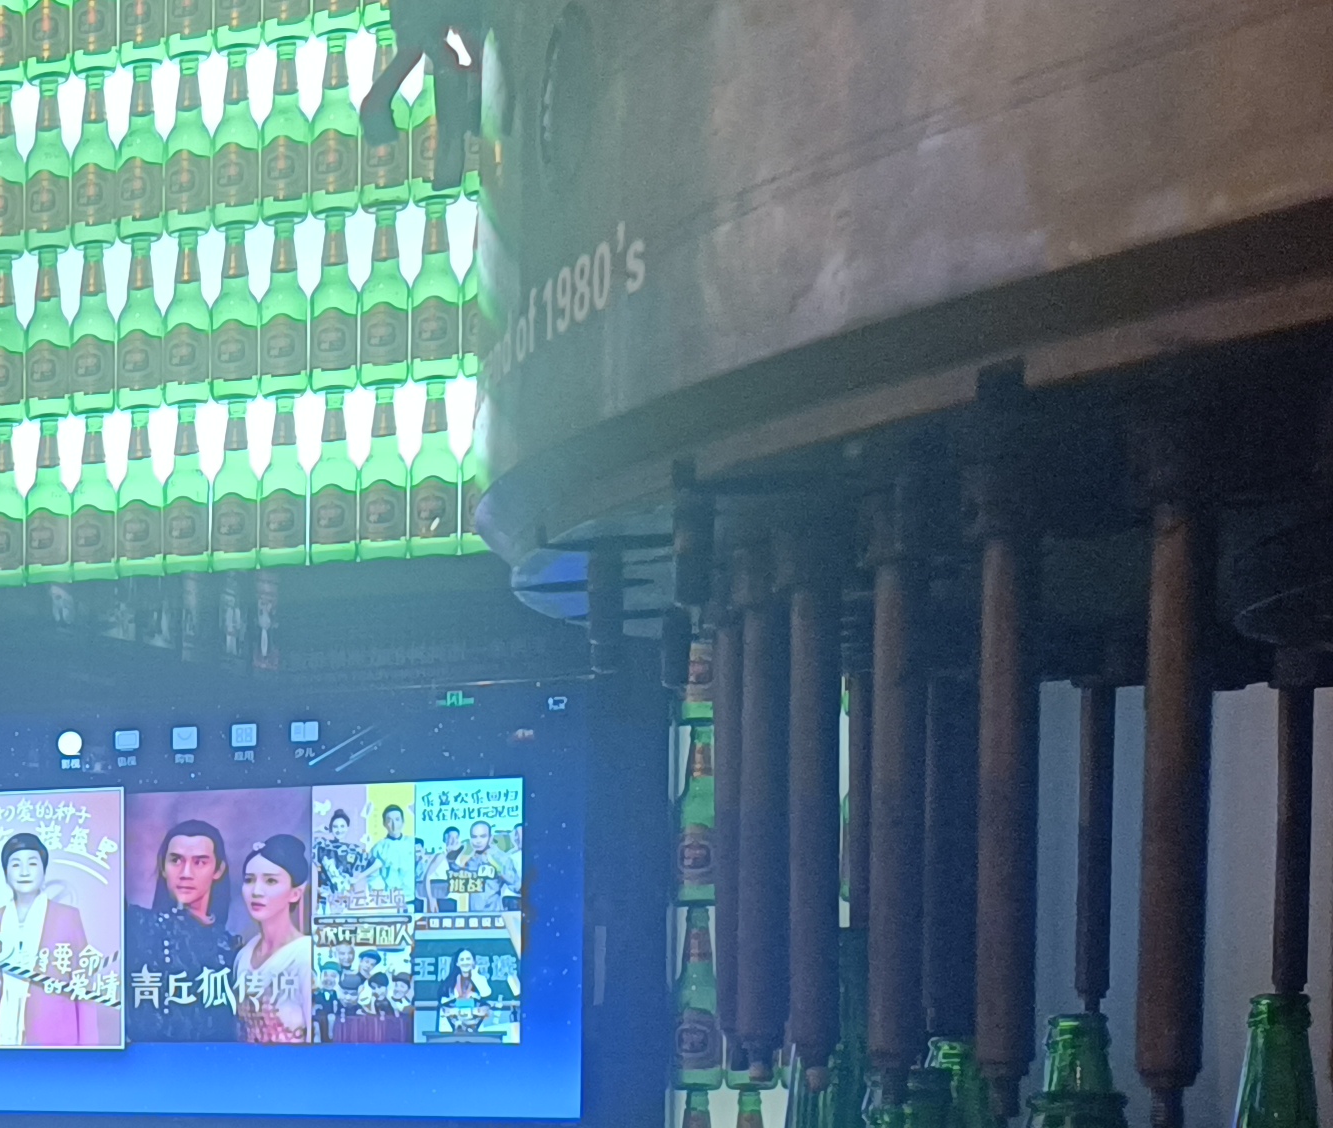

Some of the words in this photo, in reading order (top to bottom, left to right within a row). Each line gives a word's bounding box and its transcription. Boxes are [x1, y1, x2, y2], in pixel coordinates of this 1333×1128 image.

[543, 220, 647, 342] 1980's
[43, 970, 121, 1002] 的爱情
[130, 963, 300, 1016] 青丘狐传说
